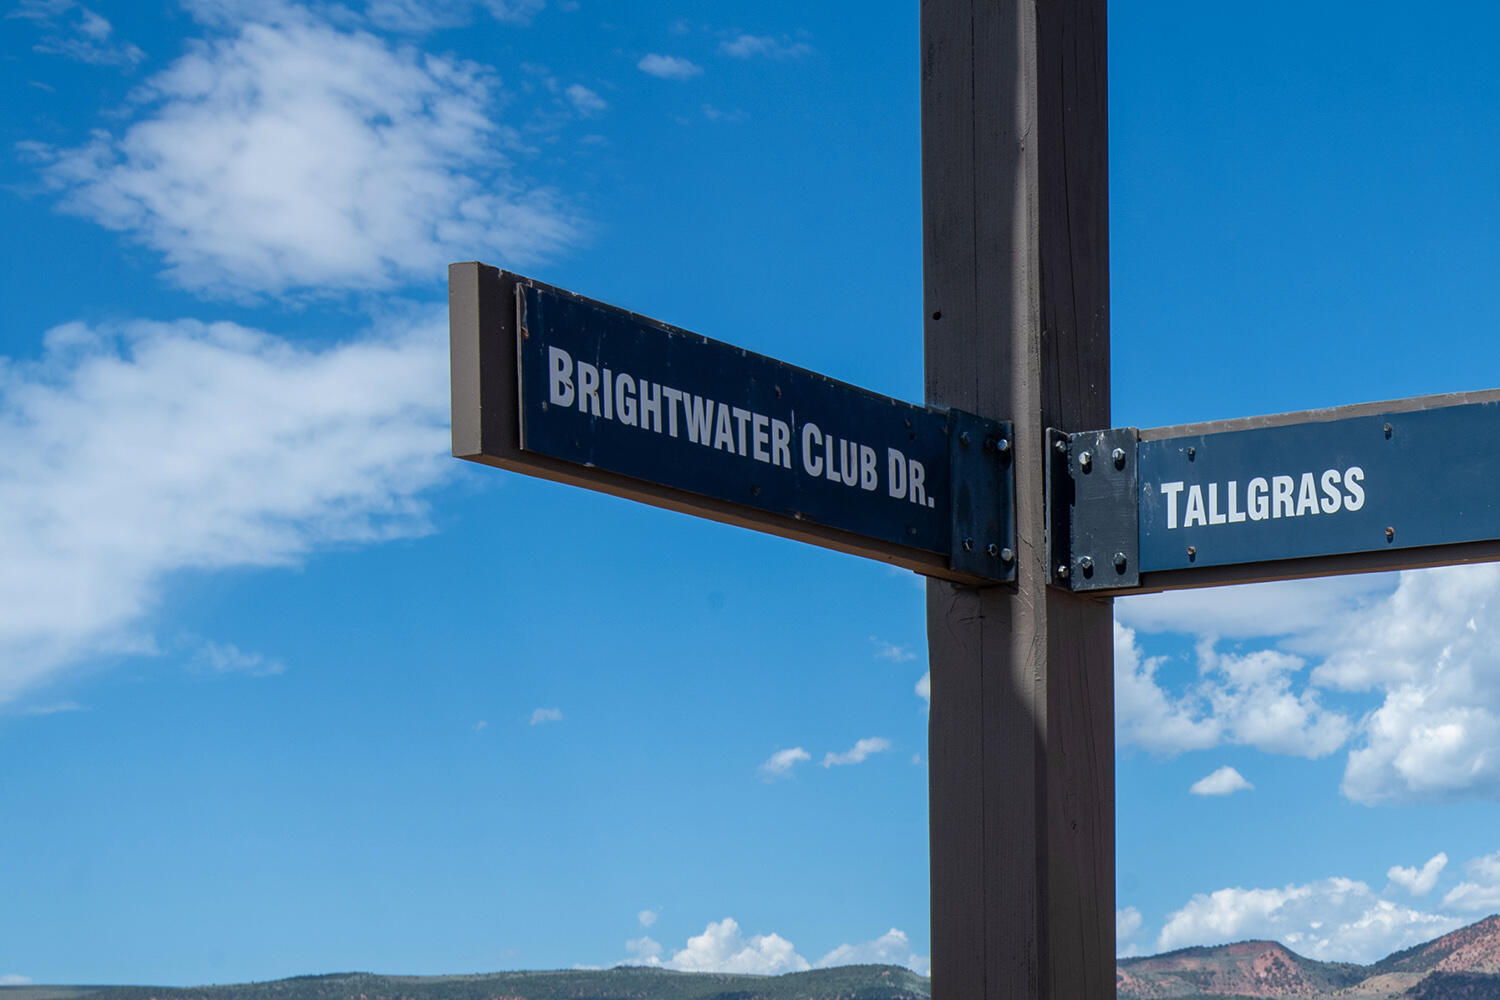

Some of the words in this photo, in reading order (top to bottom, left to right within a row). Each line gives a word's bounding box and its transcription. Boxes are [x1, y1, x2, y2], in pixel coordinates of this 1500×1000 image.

[549, 345, 792, 469] BRIGHTWATER
[802, 422, 878, 494] CLUB
[888, 446, 936, 509] DR.
[1161, 466, 1366, 530] TALLGRASS
